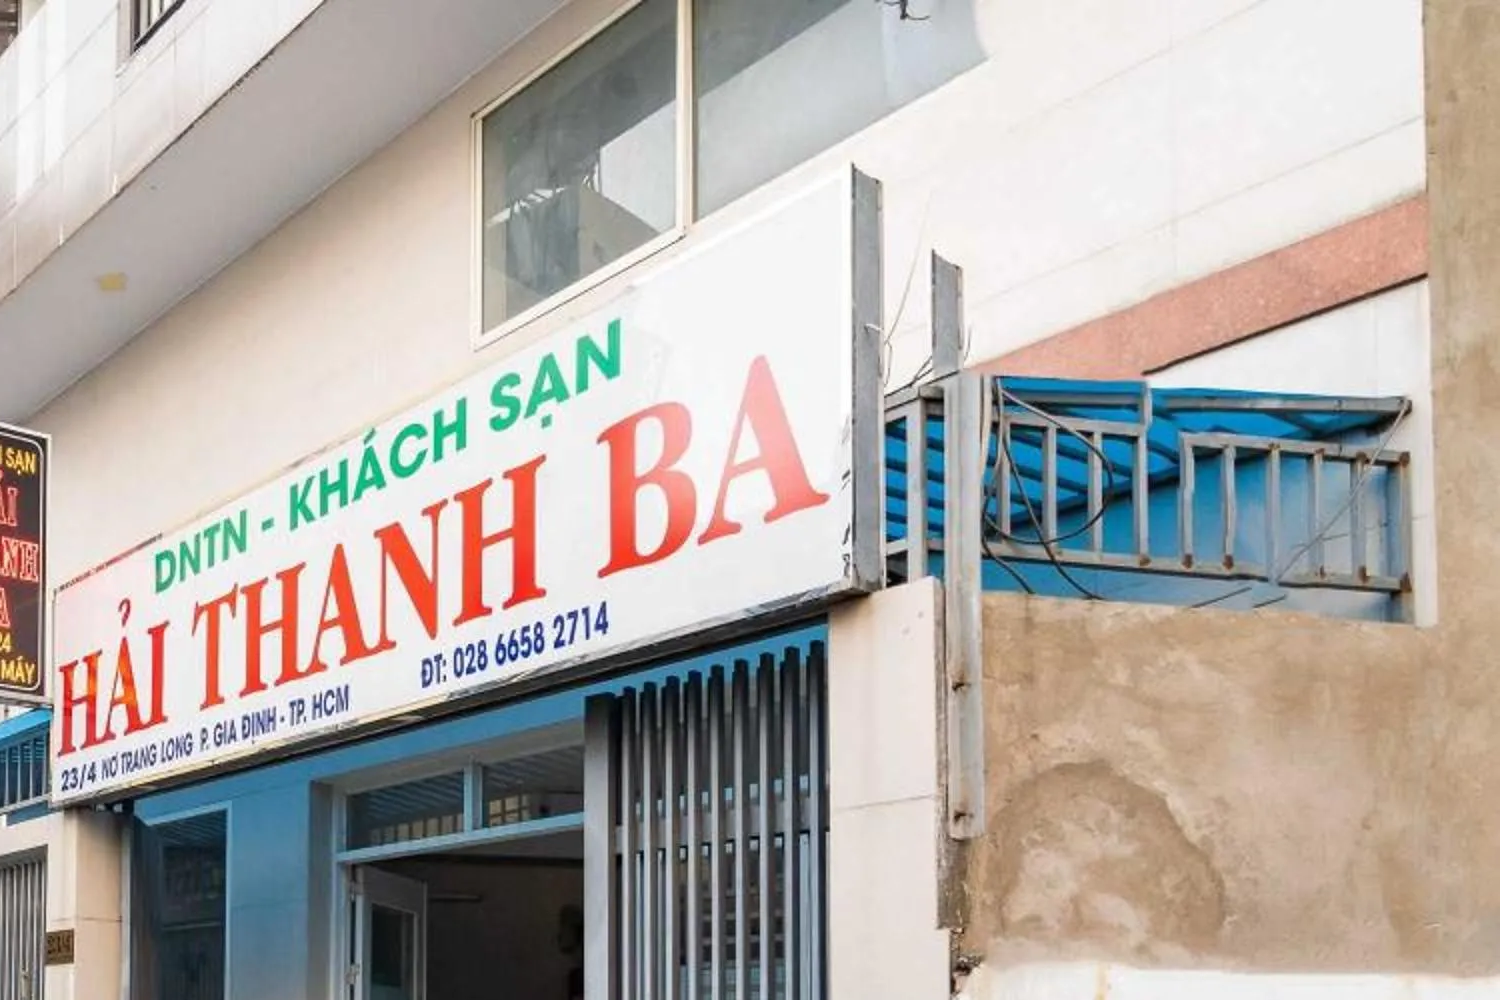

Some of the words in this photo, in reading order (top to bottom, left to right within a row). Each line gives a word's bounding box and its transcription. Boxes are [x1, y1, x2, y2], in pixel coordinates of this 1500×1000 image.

[5, 448, 37, 476] SẠN
[155, 509, 247, 594] DNTN
[289, 397, 468, 531] KHÁCH
[489, 318, 622, 432] SẠN
[57, 597, 170, 757] HẢI
[191, 453, 548, 712] THANH
[596, 354, 831, 579] BA
[1, 656, 36, 685] MÁY
[420, 652, 447, 689] ĐT:
[453, 639, 489, 679] 028
[495, 620, 546, 666] 6658
[552, 600, 609, 649] 2714
[61, 761, 97, 791] 23/4
[121, 743, 158, 775] TRANG
[160, 732, 194, 763] LONG
[199, 727, 209, 751] P.
[213, 719, 237, 747] GIA
[241, 705, 277, 745] ĐỊNH
[289, 698, 307, 727] TP.
[311, 684, 350, 721] HCM
